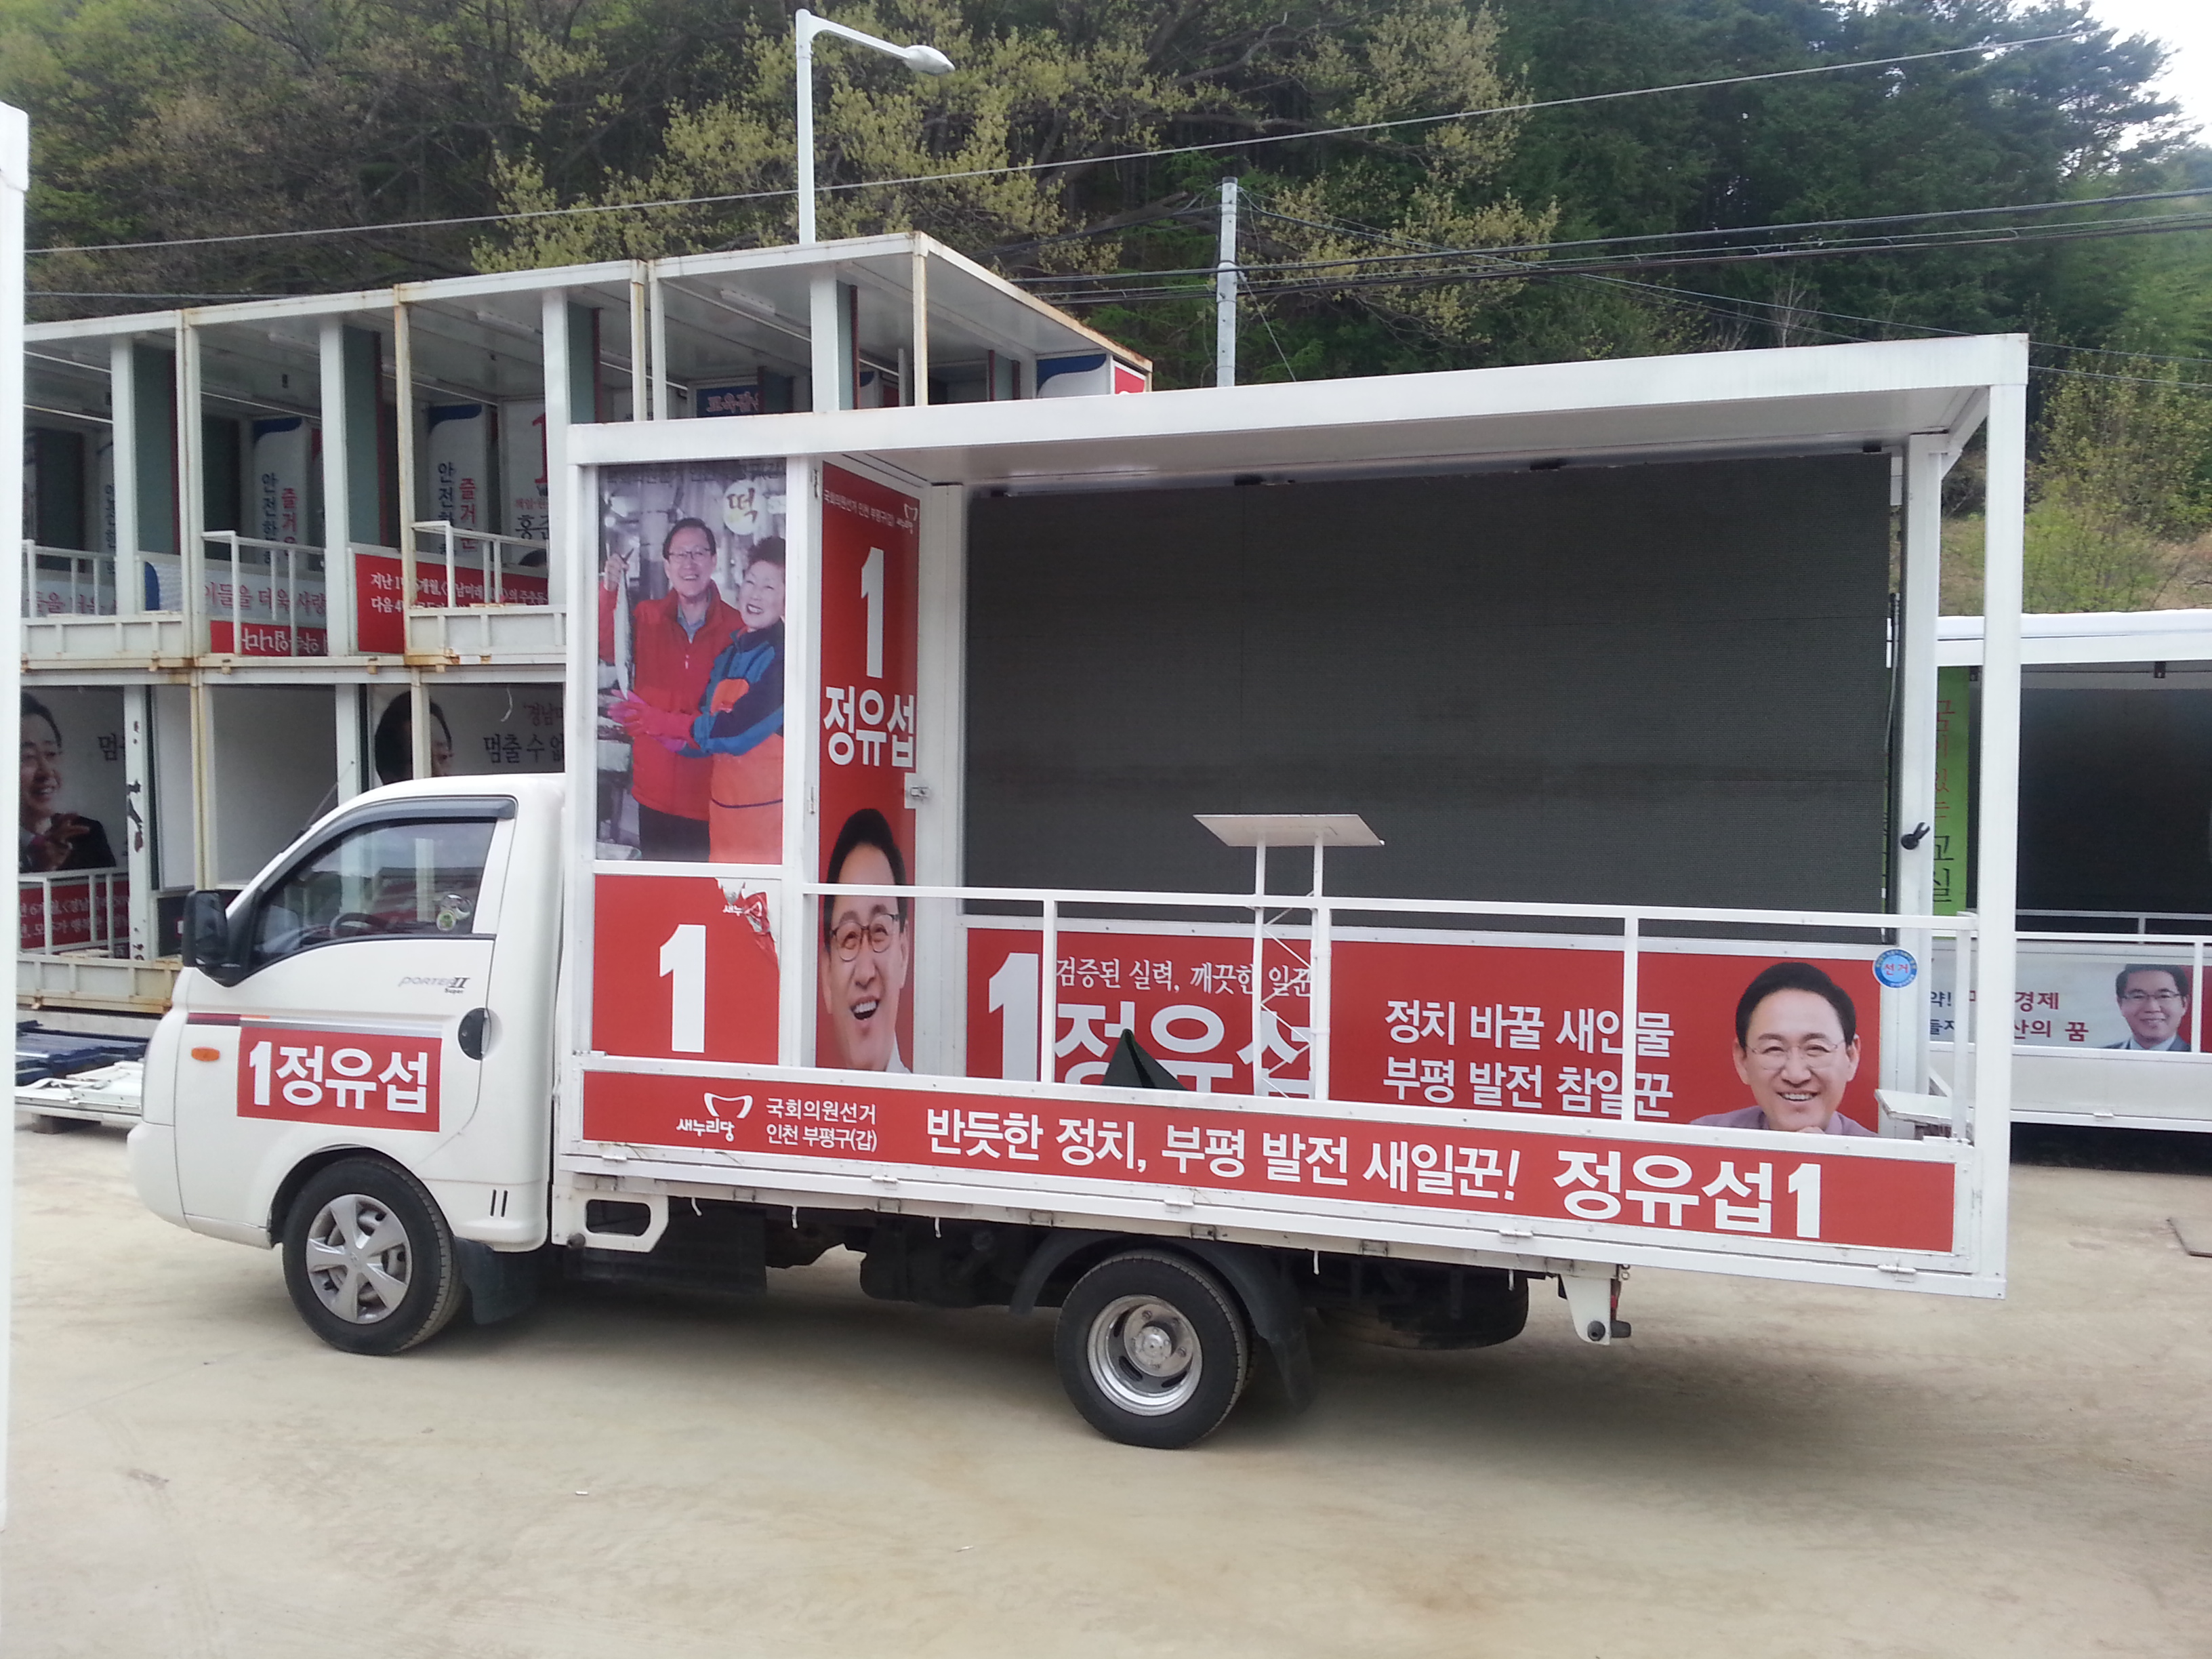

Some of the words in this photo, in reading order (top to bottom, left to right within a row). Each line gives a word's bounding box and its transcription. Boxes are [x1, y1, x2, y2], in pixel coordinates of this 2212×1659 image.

[726, 487, 758, 523] 떡
[370, 573, 392, 590] 지난
[371, 596, 393, 613] 다음
[861, 546, 884, 678] 1
[823, 685, 915, 768] 정유섭
[98, 733, 126, 761] 멈
[483, 733, 522, 764] 멈출
[526, 733, 545, 763] 수
[1056, 956, 1121, 989] 검증된
[1128, 958, 1181, 994] 실력,
[1883, 963, 1909, 976] 선거
[659, 924, 706, 1053] 1
[2015, 991, 2059, 1012] 경제
[988, 951, 1039, 1082] 1
[1385, 999, 1456, 1046] 정치
[1469, 1003, 1545, 1050] 바꿀
[1555, 1008, 1675, 1058] 새인물
[2064, 1021, 2089, 1042] 꿈
[1383, 1056, 1455, 1104] 부평
[1469, 1062, 1542, 1109] 발전
[1555, 1066, 1674, 1118] 참일꾼
[765, 1097, 877, 1125] 국회의원선거
[676, 1118, 735, 1142] 새누리당
[766, 1124, 799, 1146] 인천
[802, 1126, 878, 1152] 부평구(갑)
[926, 1107, 1044, 1161] 반듯한
[1055, 1117, 1147, 1174] 정치,
[1161, 1123, 1246, 1179] 부평
[1262, 1132, 1349, 1187] 발전
[1362, 1140, 1521, 1202] 새일꾼!
